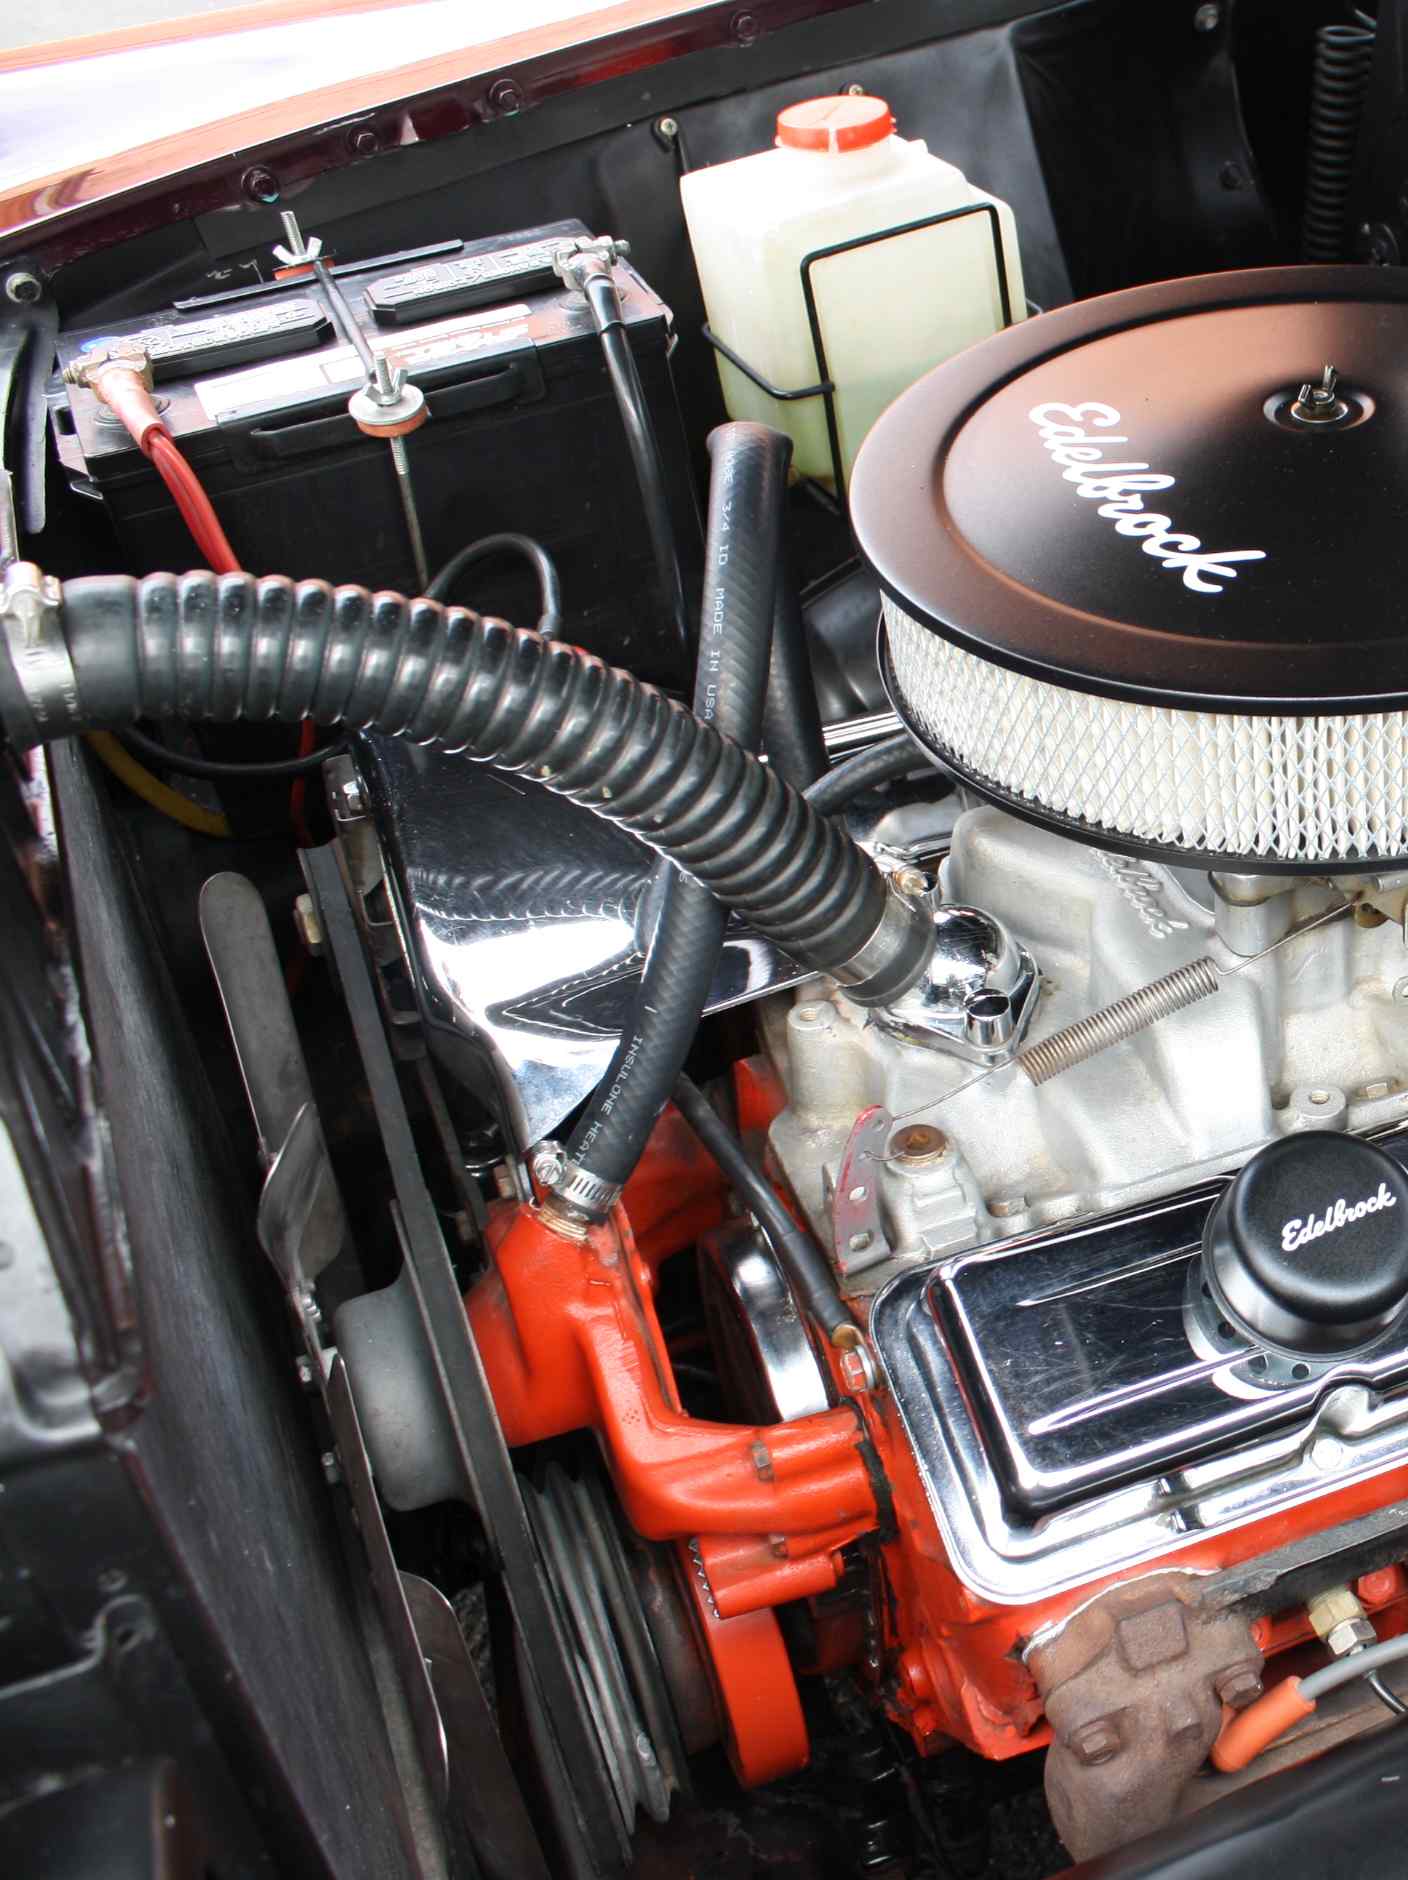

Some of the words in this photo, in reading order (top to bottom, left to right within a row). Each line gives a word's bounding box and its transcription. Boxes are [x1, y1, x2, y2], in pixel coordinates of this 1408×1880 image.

[719, 501, 733, 532] 3/4
[1028, 401, 1267, 593] Edelbrock
[718, 544, 730, 566] ID
[713, 587, 726, 636] MADE
[708, 648, 721, 672] IN
[704, 684, 718, 721] USA
[600, 1034, 645, 1117] INSULONE
[1281, 1182, 1397, 1252] Edelbrock
